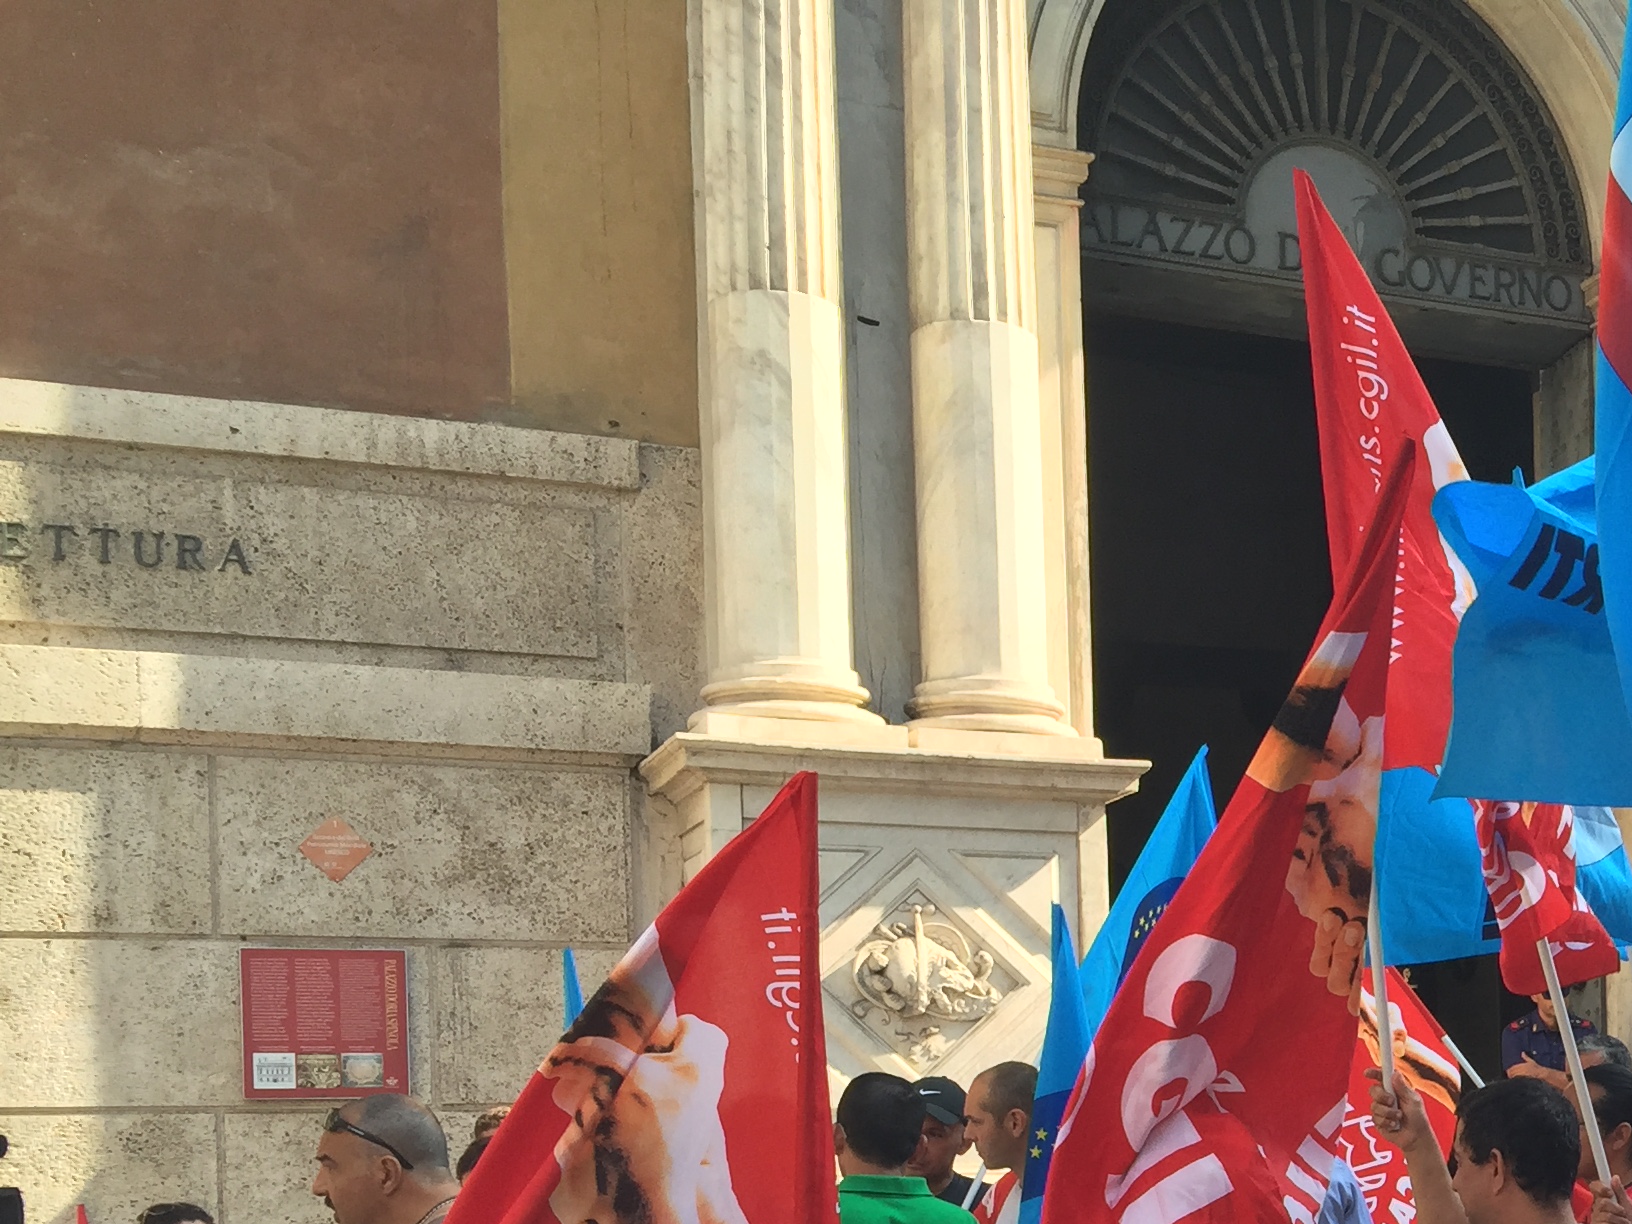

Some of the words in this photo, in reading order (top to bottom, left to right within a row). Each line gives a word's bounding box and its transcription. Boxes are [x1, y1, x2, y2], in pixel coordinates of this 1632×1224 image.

[1085, 207, 1257, 265] ALAZZO
[1374, 247, 1572, 312] GOVERNO
[0, 521, 253, 575] ETTURA
